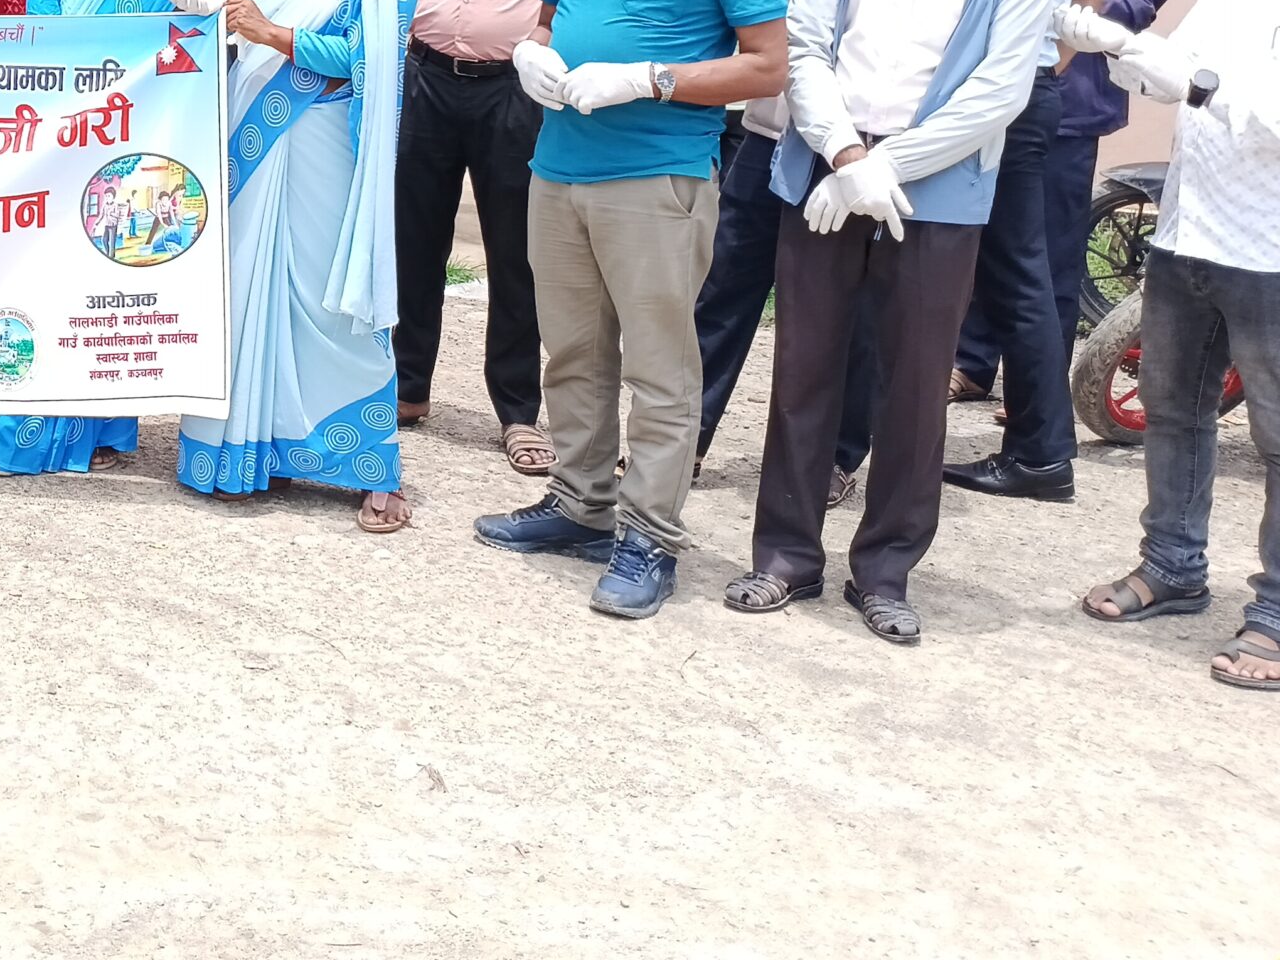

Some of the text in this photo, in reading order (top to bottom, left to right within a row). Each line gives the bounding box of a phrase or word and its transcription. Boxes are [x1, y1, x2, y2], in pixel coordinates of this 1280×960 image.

[57, 92, 134, 148] गरी
[86, 291, 158, 309] आयोजक
[69, 310, 179, 329] लालझाडी गाउँपालिका
[83, 331, 153, 348] कार्यपालिकाको
[158, 330, 199, 345] कार्यालय
